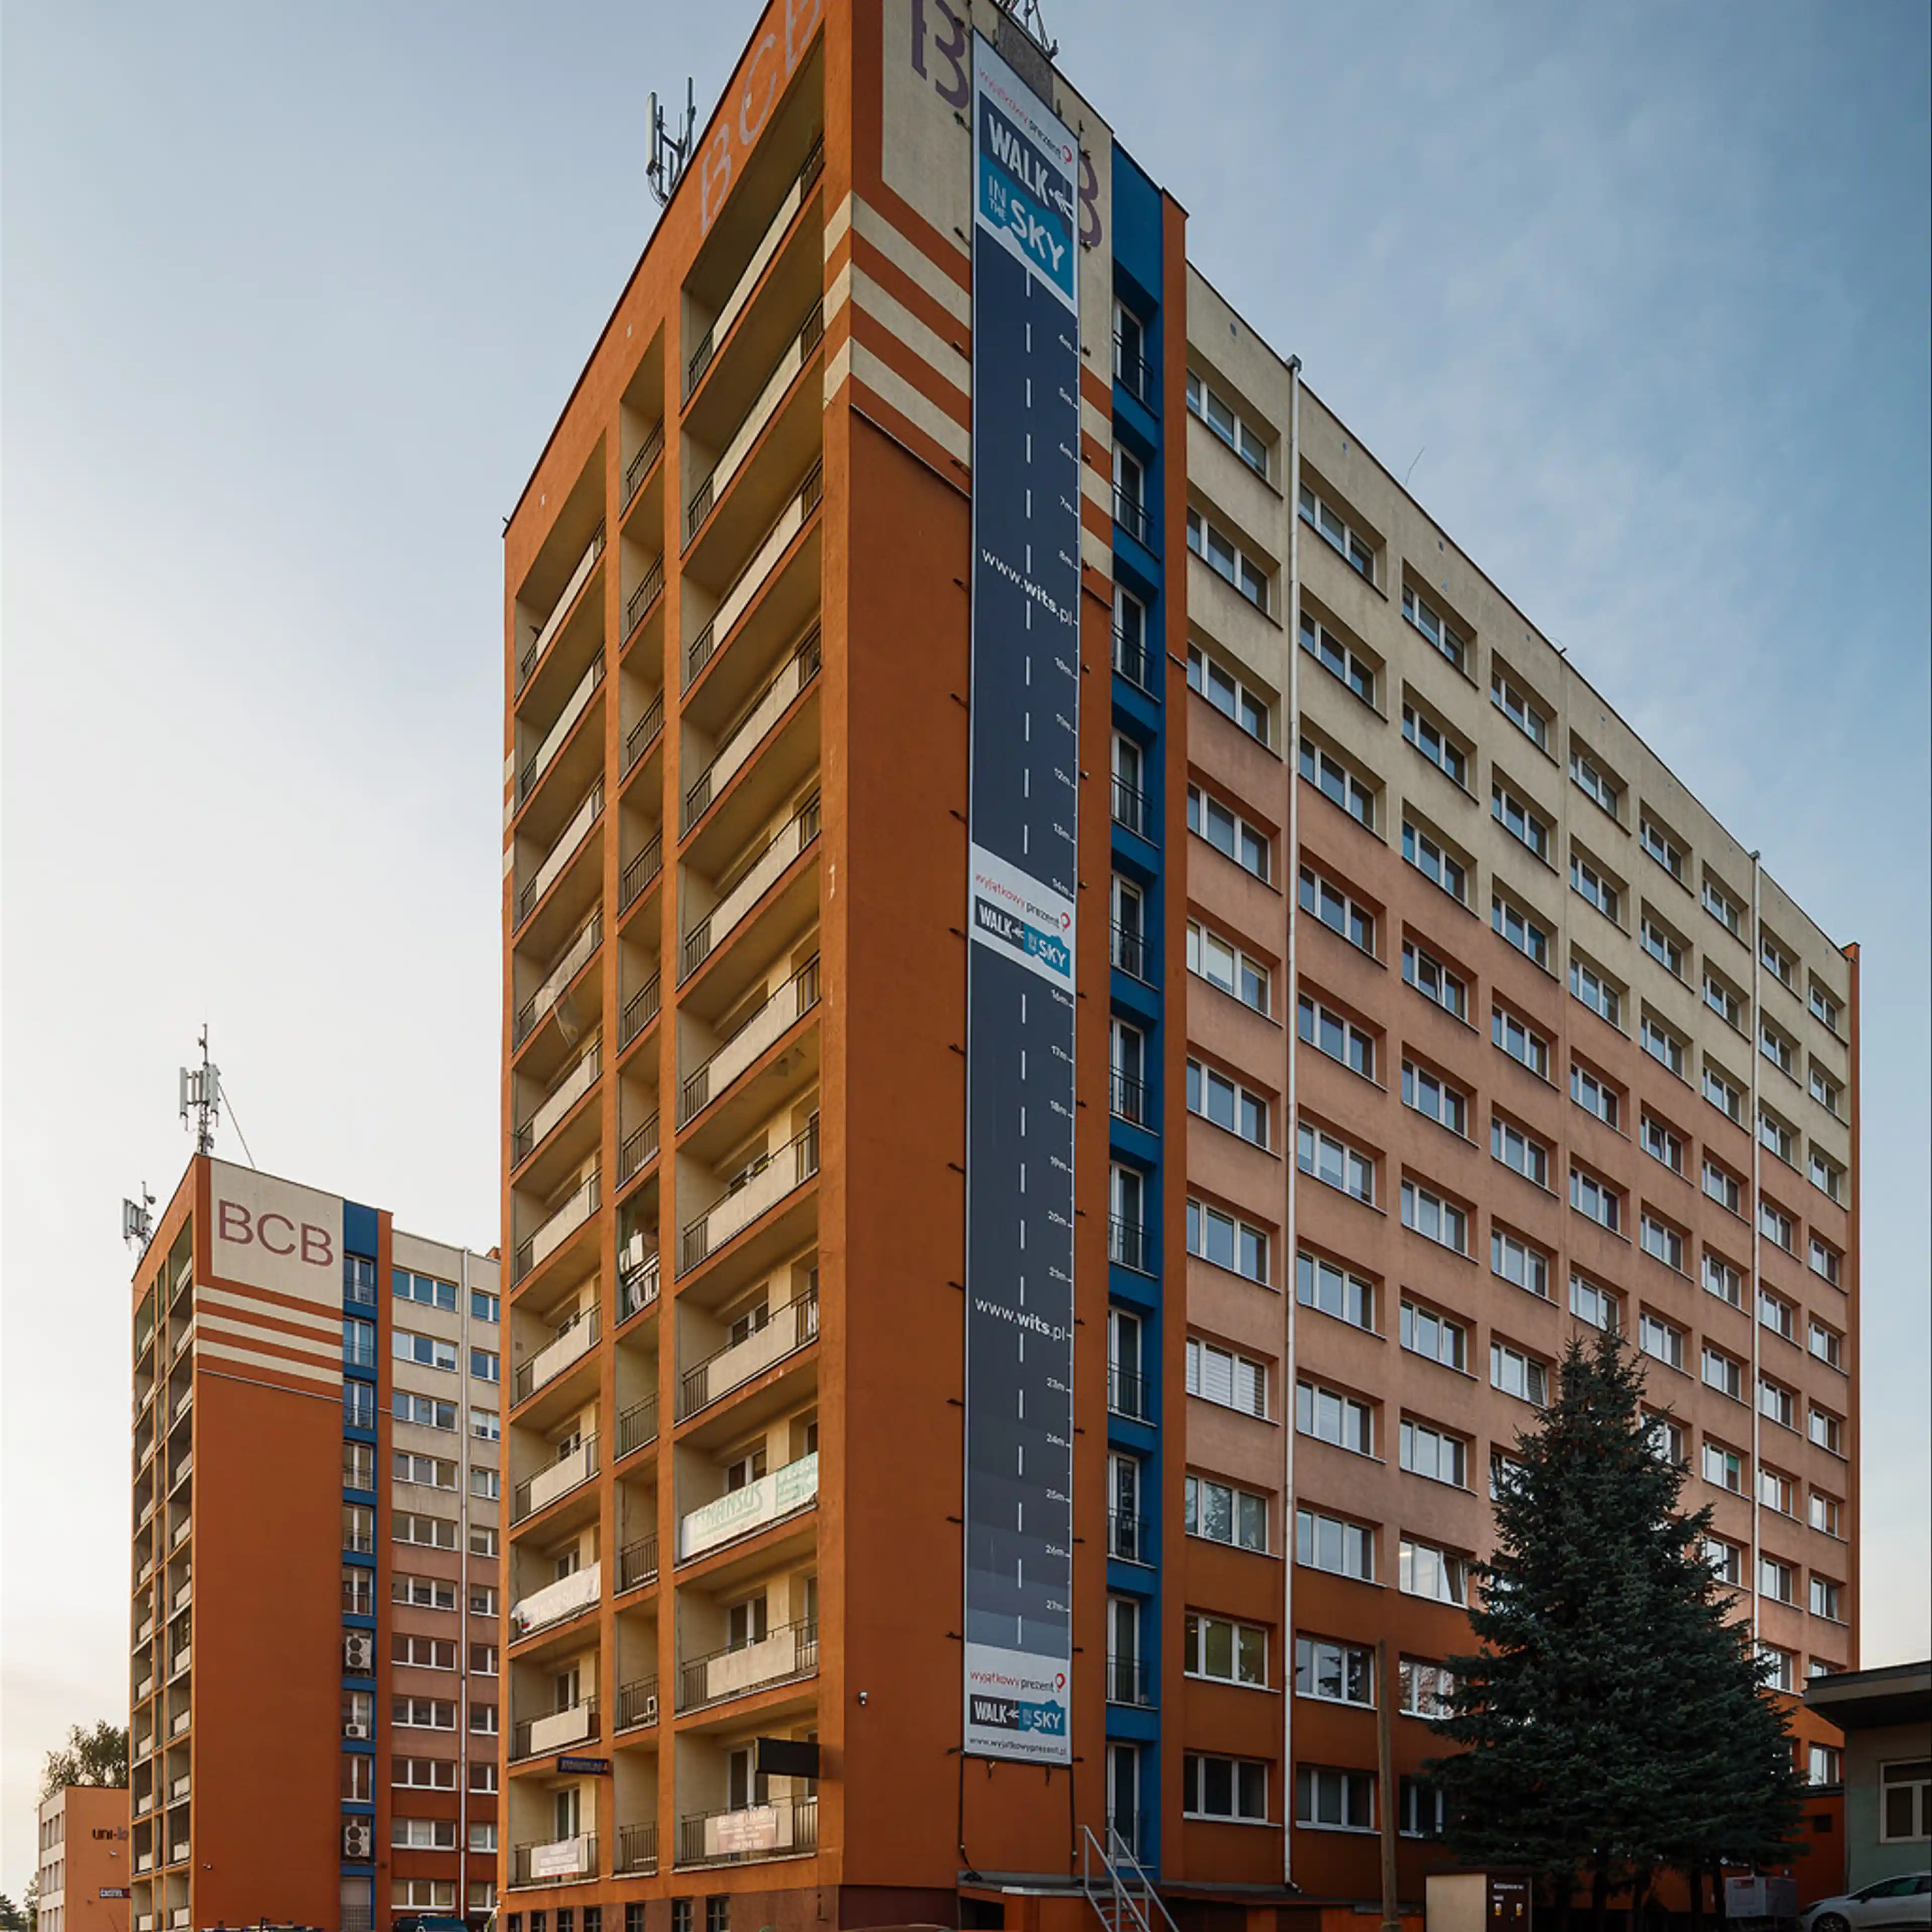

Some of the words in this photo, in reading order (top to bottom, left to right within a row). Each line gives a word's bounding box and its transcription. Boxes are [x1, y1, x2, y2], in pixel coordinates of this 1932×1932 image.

[989, 113, 1049, 207] WALK
[989, 176, 1006, 207] IN
[990, 198, 1006, 221] THE
[1011, 199, 1065, 272] SKY
[982, 548, 1072, 626] www.wits.pl
[979, 904, 1012, 939] WALK
[1038, 939, 1066, 968] SKY
[1051, 1044, 1068, 1061] 17m
[219, 1199, 334, 1267] BCB
[1048, 1210, 1067, 1226] 20m
[975, 1298, 1066, 1341] www.wits.pl
[1021, 1679, 1055, 1693] prezent
[975, 1701, 1007, 1723] WALK
[1033, 1710, 1062, 1729] SKY
